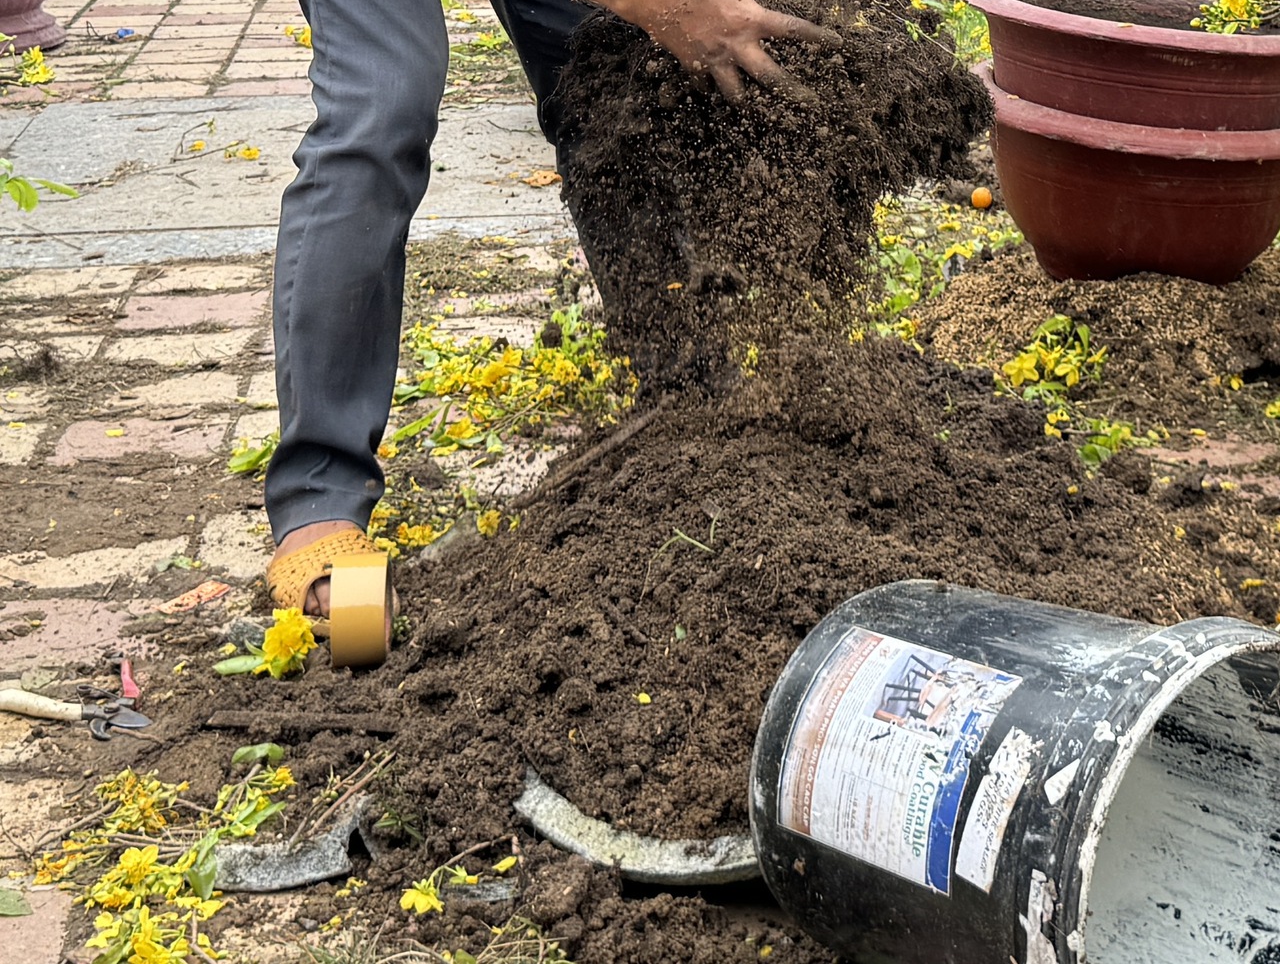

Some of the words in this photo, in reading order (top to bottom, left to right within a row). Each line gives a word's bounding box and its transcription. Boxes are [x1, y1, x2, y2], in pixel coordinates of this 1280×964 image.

[902, 783, 921, 843] Coatings
[911, 781, 936, 857] Curable
[979, 829, 994, 873] SEALER
